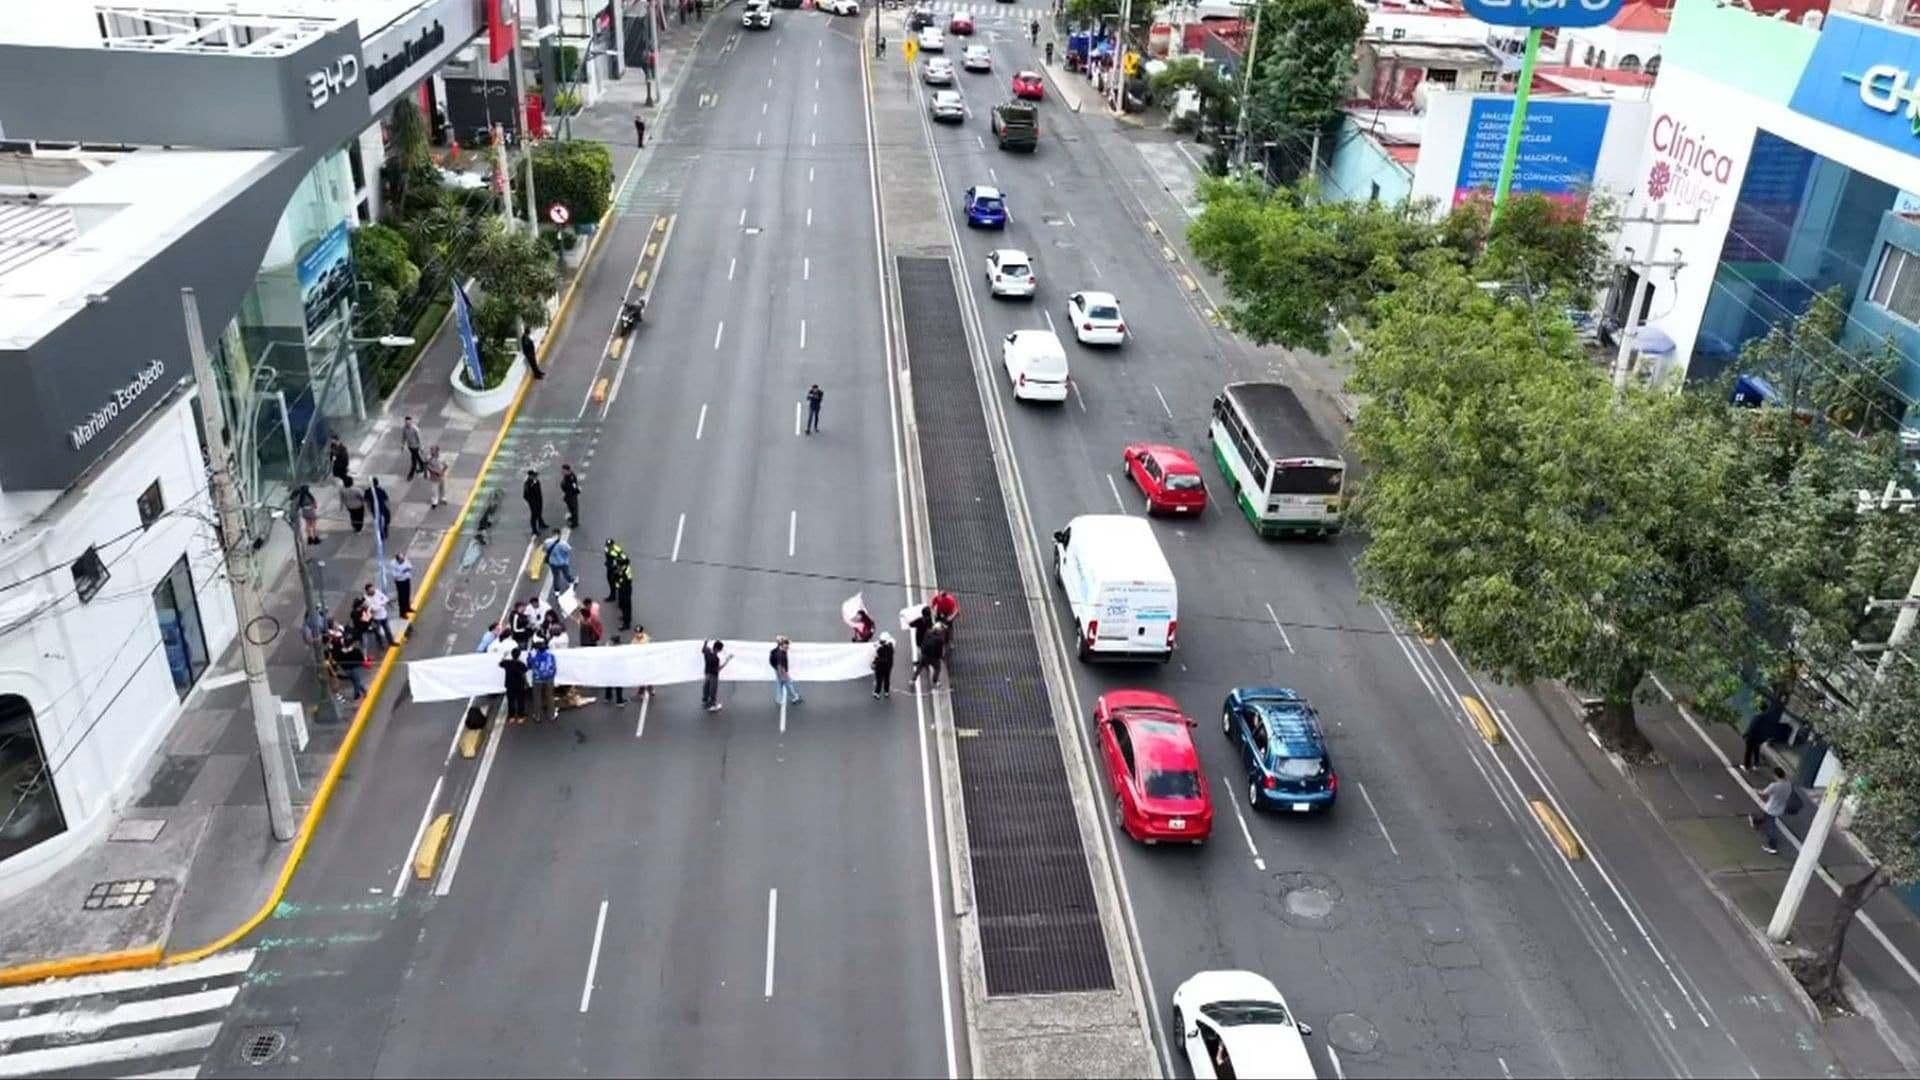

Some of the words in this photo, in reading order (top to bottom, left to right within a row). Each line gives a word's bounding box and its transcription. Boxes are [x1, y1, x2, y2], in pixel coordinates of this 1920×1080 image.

[310, 54, 358, 110] BYD
[1653, 114, 1733, 184] Clínica
[72, 401, 119, 450] Mariano
[115, 359, 165, 410] Escobedo
